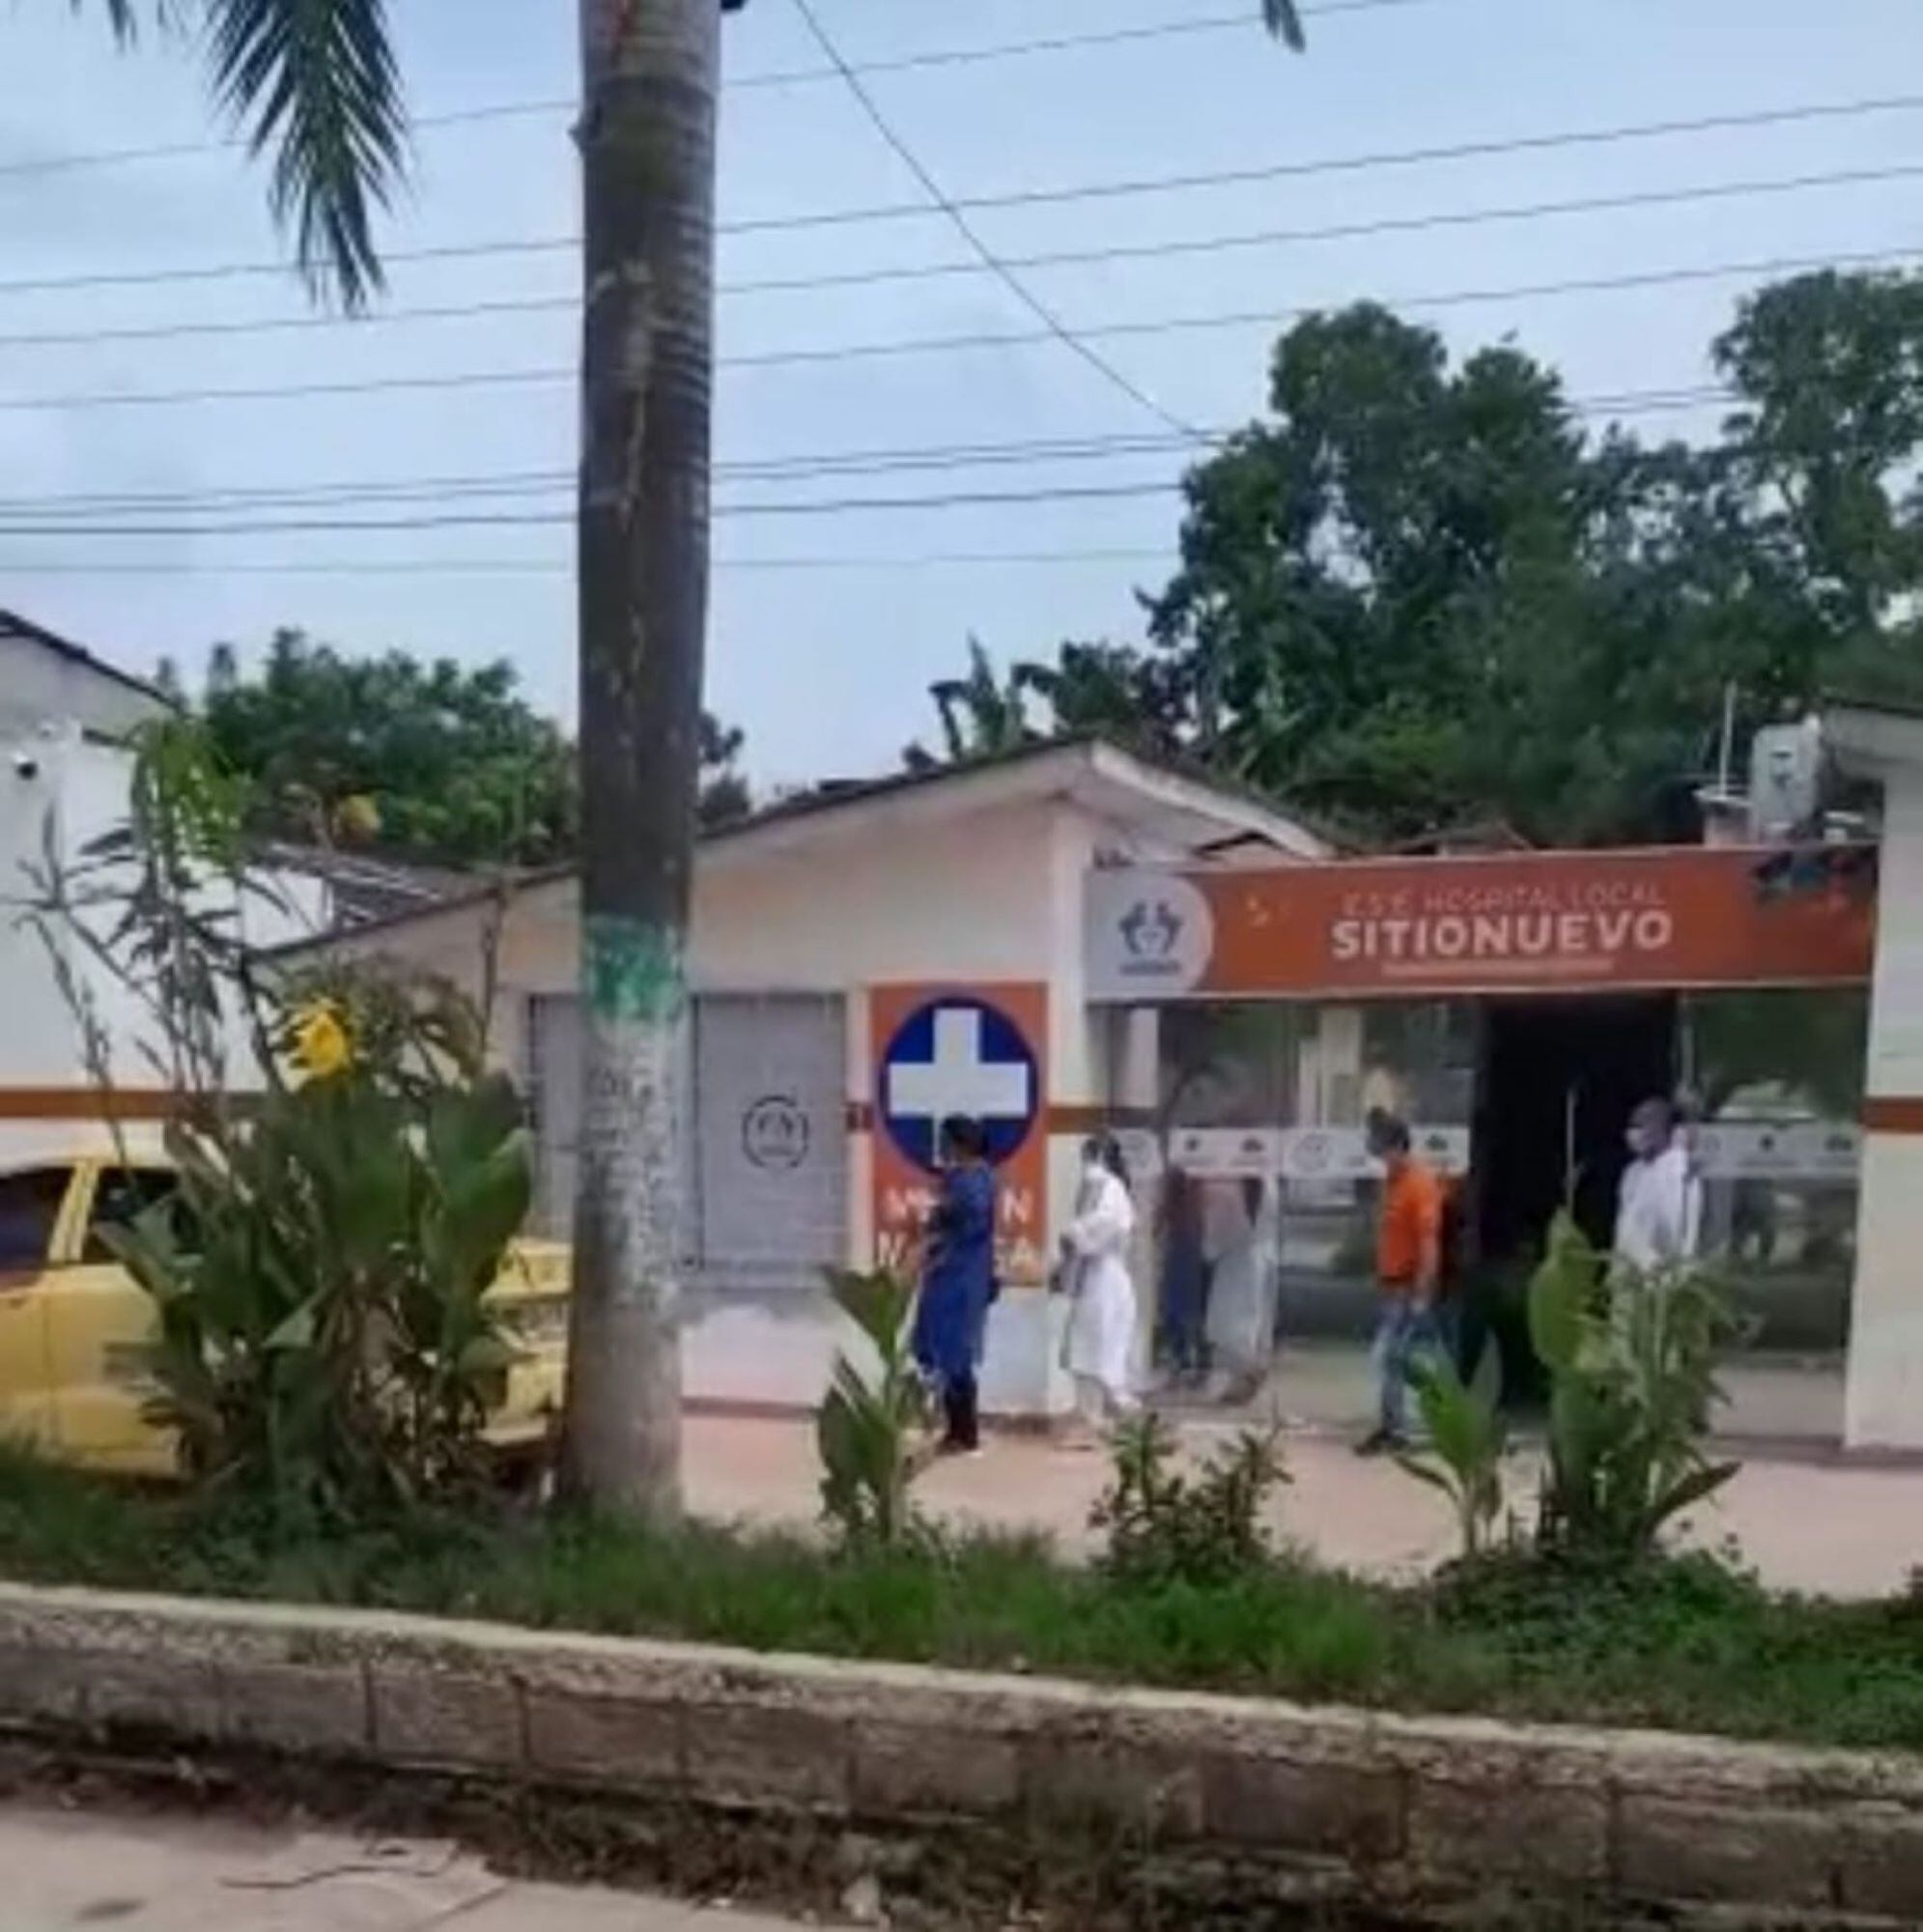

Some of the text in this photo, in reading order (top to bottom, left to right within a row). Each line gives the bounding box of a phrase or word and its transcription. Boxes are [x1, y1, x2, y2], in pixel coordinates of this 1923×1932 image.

[1424, 884, 1564, 913] HOSPITAL
[1570, 880, 1667, 906] LOCAL
[1332, 909, 1673, 959] SITIONUEVO
